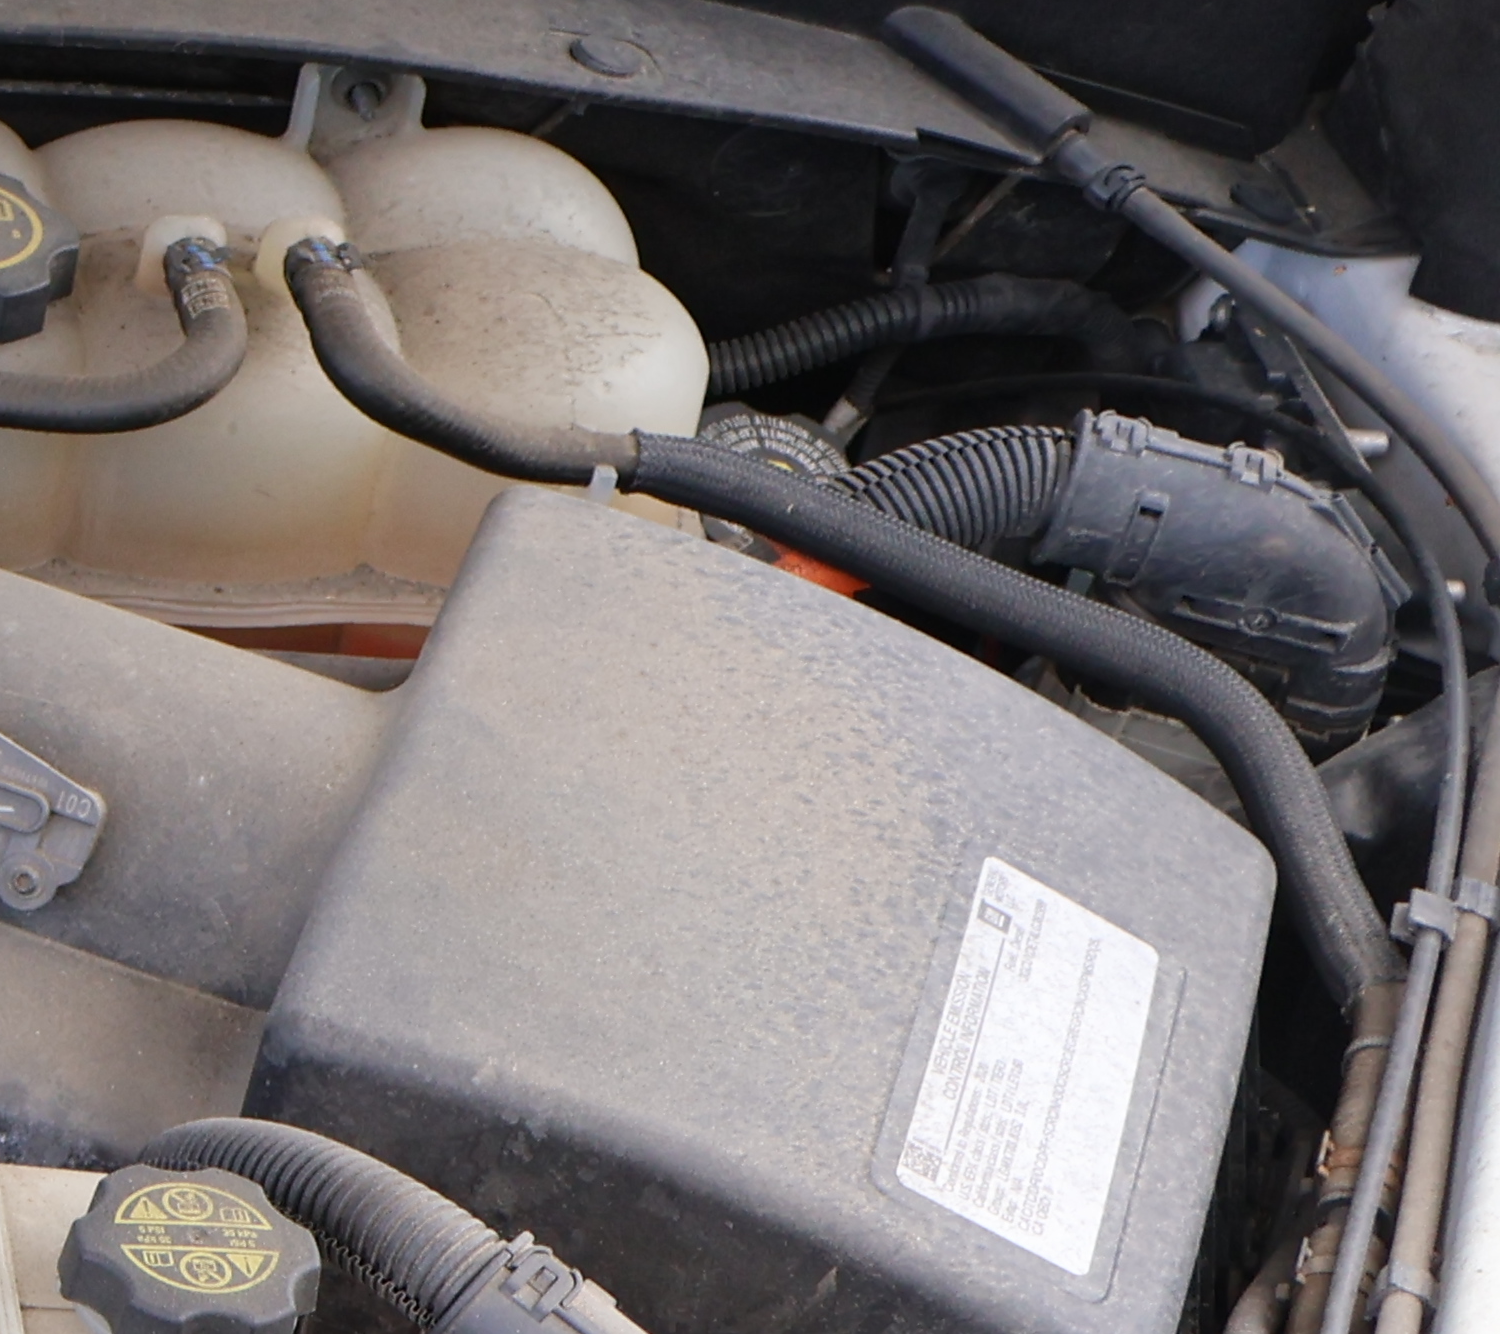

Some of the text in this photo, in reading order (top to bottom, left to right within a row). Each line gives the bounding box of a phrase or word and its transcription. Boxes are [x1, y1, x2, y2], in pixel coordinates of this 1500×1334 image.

[933, 971, 970, 1074] VEHICLE EMISSION
[943, 966, 989, 1099] CONTROL INFORMATION
[944, 1150, 964, 1191] Conforms
[971, 1139, 985, 1161] class
[973, 1165, 994, 1207] California
[986, 1143, 1000, 1166] class
